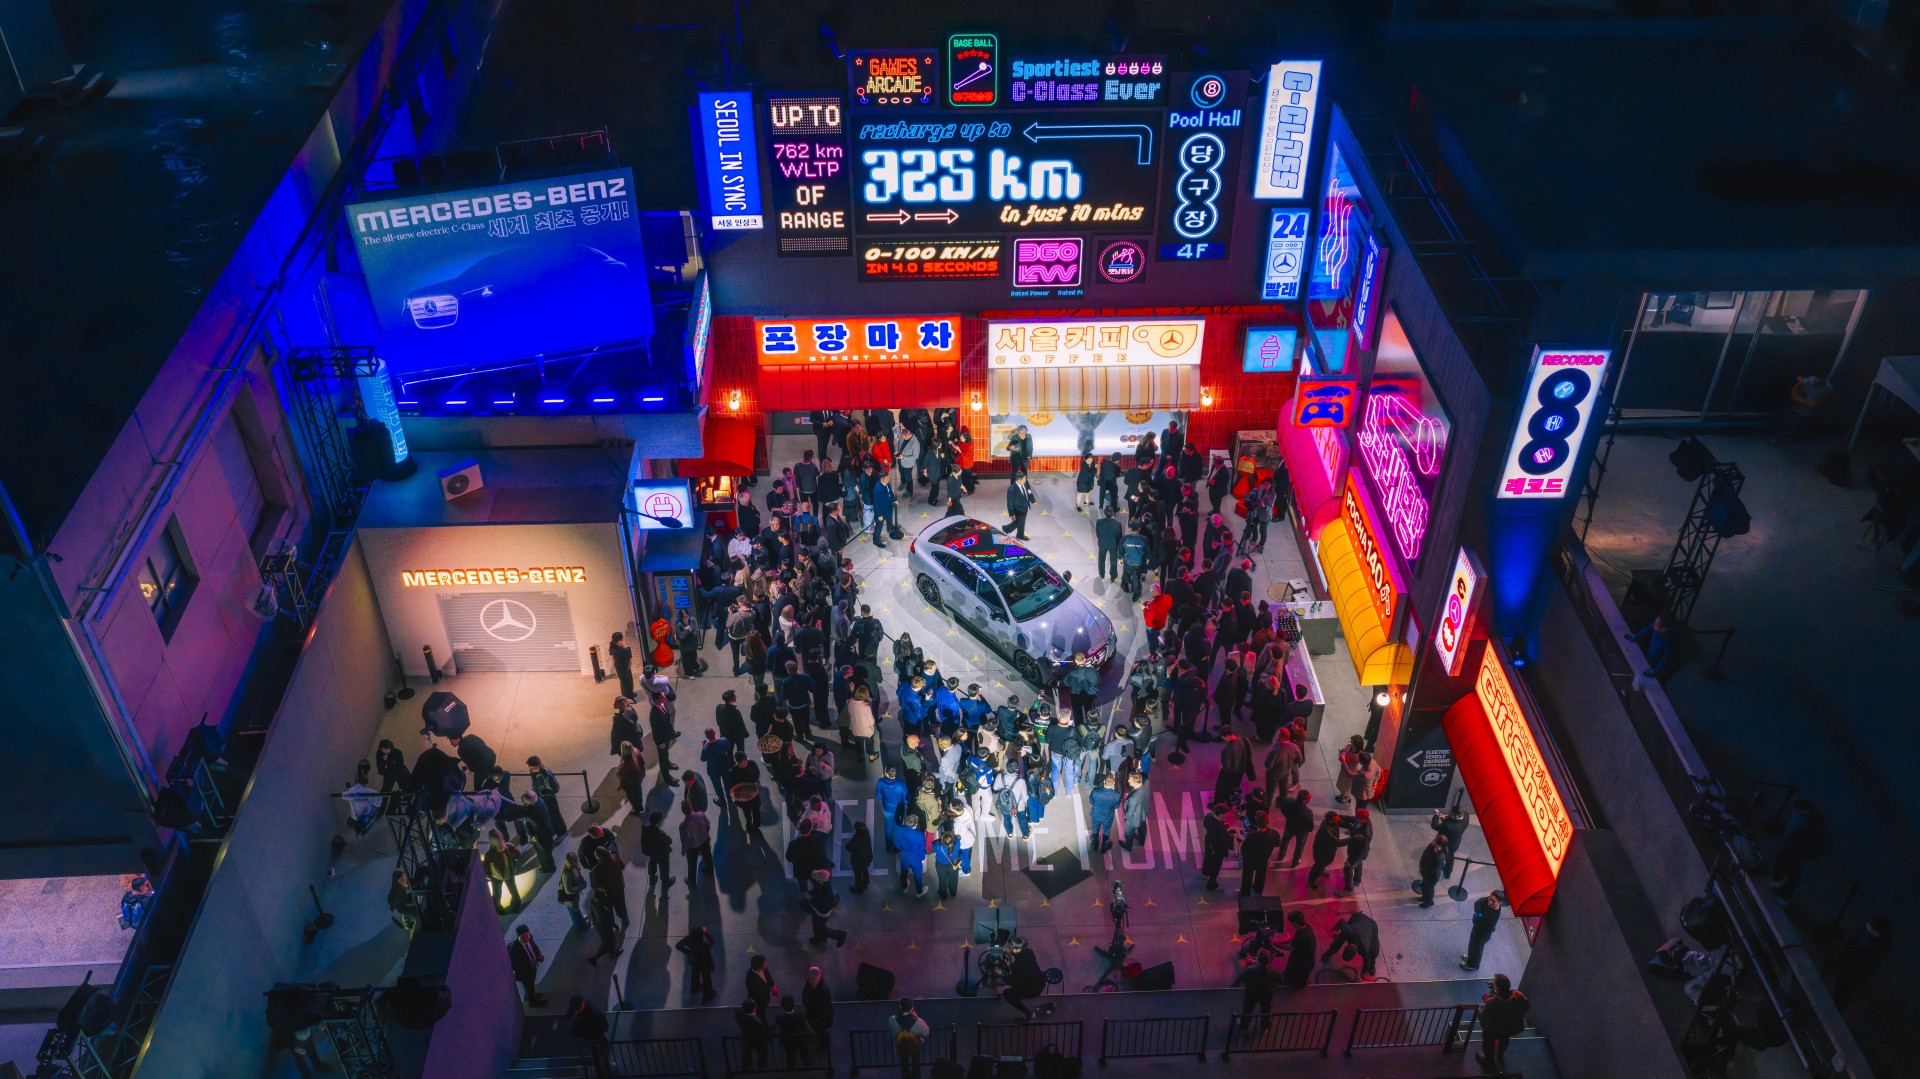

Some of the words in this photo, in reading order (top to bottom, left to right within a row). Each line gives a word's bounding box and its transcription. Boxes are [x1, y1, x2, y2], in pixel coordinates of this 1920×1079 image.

[953, 39, 972, 47] BASE
[974, 38, 993, 47] BALL
[869, 58, 917, 76] GAMES
[1012, 59, 1100, 80] Sportiest
[866, 76, 922, 93] ARCADE
[1012, 80, 1099, 101] C-Class
[1104, 79, 1161, 100] Ever
[1206, 83, 1217, 95] 8
[714, 99, 741, 147] SEOUL
[771, 105, 803, 127] UP
[808, 104, 841, 126] TO
[1169, 110, 1205, 128] Pool
[1208, 109, 1242, 127] Hall
[859, 121, 957, 143] recharge
[960, 123, 985, 142] up
[988, 121, 1012, 138] to
[719, 151, 743, 171] IN
[773, 143, 809, 159] 762
[816, 143, 843, 159] km
[779, 161, 840, 178] WLTP
[862, 148, 976, 203] 325
[988, 148, 1082, 202] km
[722, 174, 747, 211] SYNC
[796, 185, 826, 206] OF
[1184, 144, 1214, 228] 당구장
[356, 177, 627, 233] MERCEDES-BENZ
[1000, 205, 1020, 224] in
[1020, 204, 1067, 227] just
[1070, 203, 1092, 222] 10
[1092, 203, 1145, 222] mins
[487, 214, 530, 238] 세계
[534, 208, 577, 232] 최초
[580, 200, 630, 226] 공개!
[717, 219, 732, 227] 서울
[735, 218, 758, 227] 인싱크
[780, 211, 845, 229] RANGE
[1273, 214, 1305, 239] 24
[362, 235, 381, 246] The
[382, 230, 415, 243] all-new
[416, 226, 450, 237] electric
[451, 222, 485, 233] C-Class
[864, 246, 937, 261] 0-100
[938, 245, 1000, 260] KM/H
[1018, 242, 1079, 262] 360
[1176, 243, 1209, 259] 4F
[866, 262, 888, 274] IN
[891, 262, 919, 273] 4.0
[922, 260, 999, 273] SECONDS
[1018, 264, 1078, 283] KW
[1264, 282, 1298, 298] 빨래
[762, 320, 955, 355] 포장마차
[995, 324, 1130, 353] 서울커피
[809, 354, 870, 362] STREET
[995, 353, 1127, 365] COFFEE
[1541, 354, 1605, 366] RECORDS
[1504, 478, 1564, 495] 레코드
[402, 566, 587, 587] MERCEDES-BENZ
[1480, 664, 1513, 748] Gift
[1510, 735, 1562, 862] Shop
